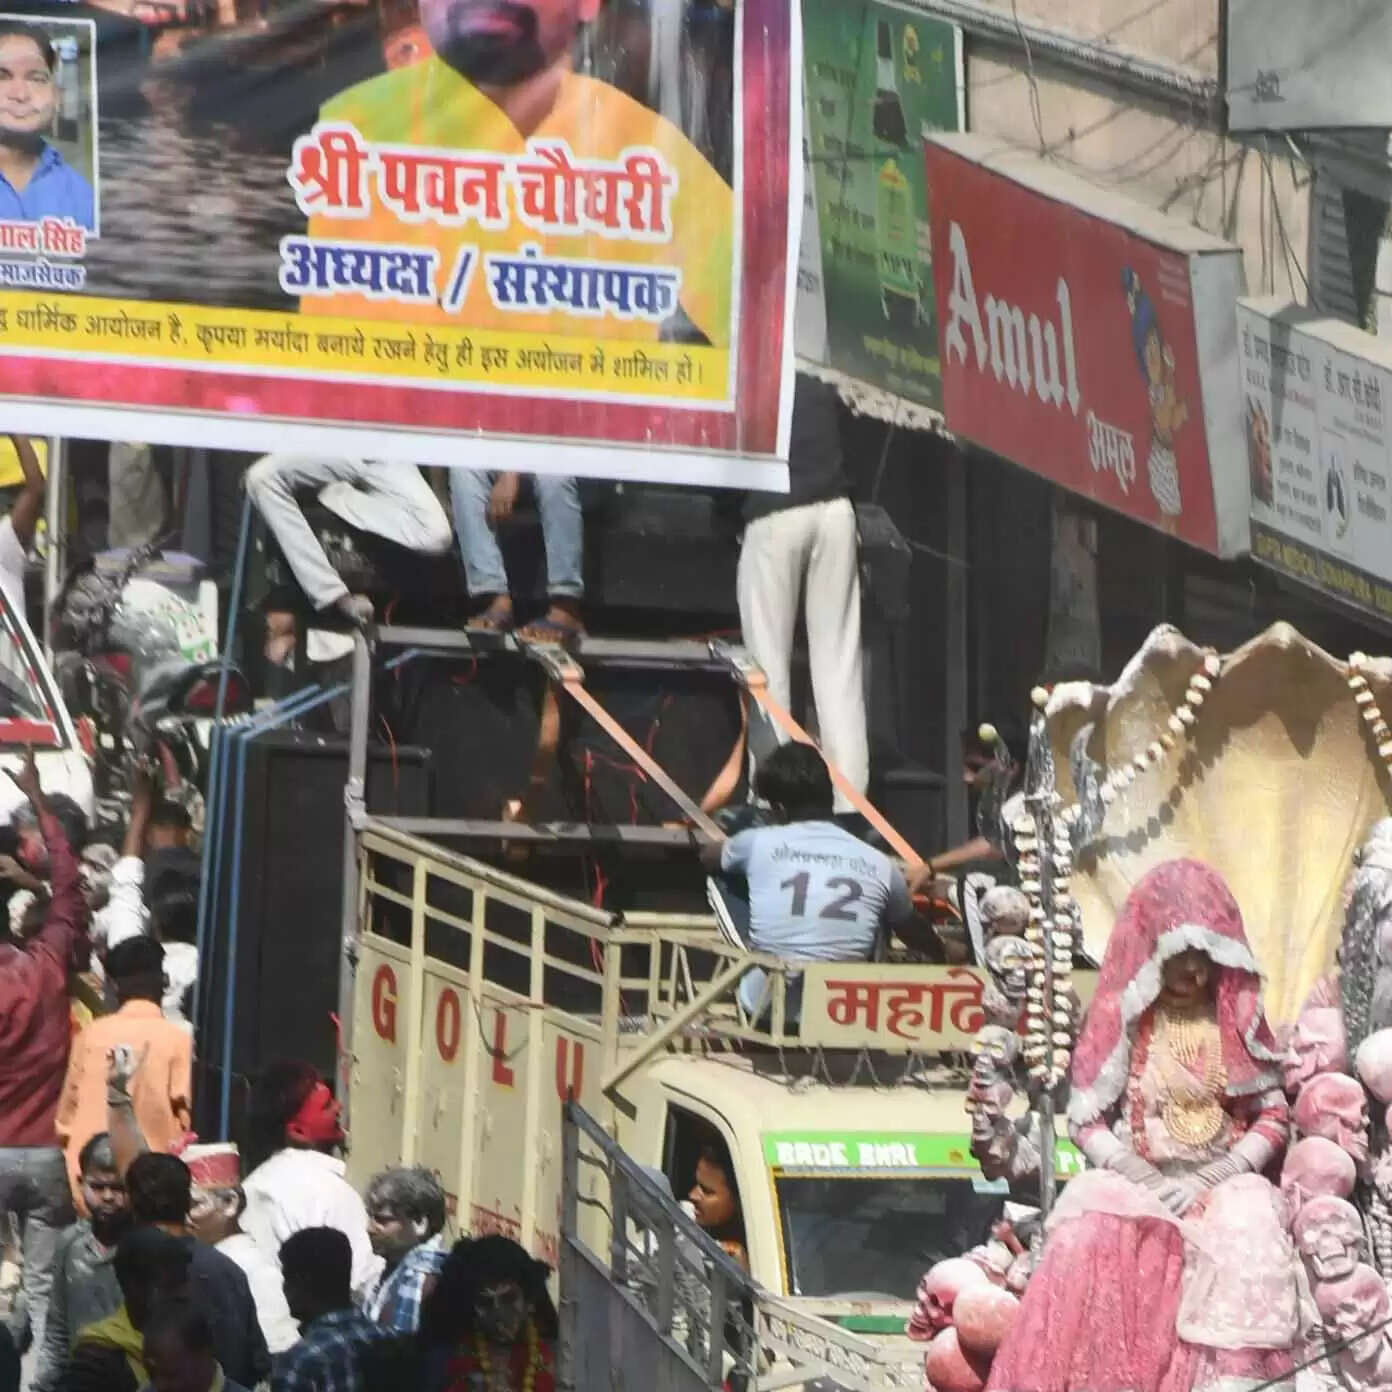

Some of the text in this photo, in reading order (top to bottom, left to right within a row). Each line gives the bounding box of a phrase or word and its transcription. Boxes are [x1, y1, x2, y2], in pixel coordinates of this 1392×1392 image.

[296, 130, 368, 209] श्री
[380, 151, 505, 220] पवन
[490, 246, 677, 316] संस्थापक
[946, 220, 1080, 416] Amul
[17, 303, 78, 333] धार्मिक
[85, 310, 161, 341] आयोजन
[196, 321, 247, 353] कृपया
[254, 319, 308, 353] मर्यादा
[424, 333, 449, 373] हेतु
[455, 336, 473, 367] ही
[481, 346, 509, 373] इस
[1086, 410, 1136, 496] अमूल
[780, 870, 862, 922] 12
[825, 967, 986, 1041] महादे
